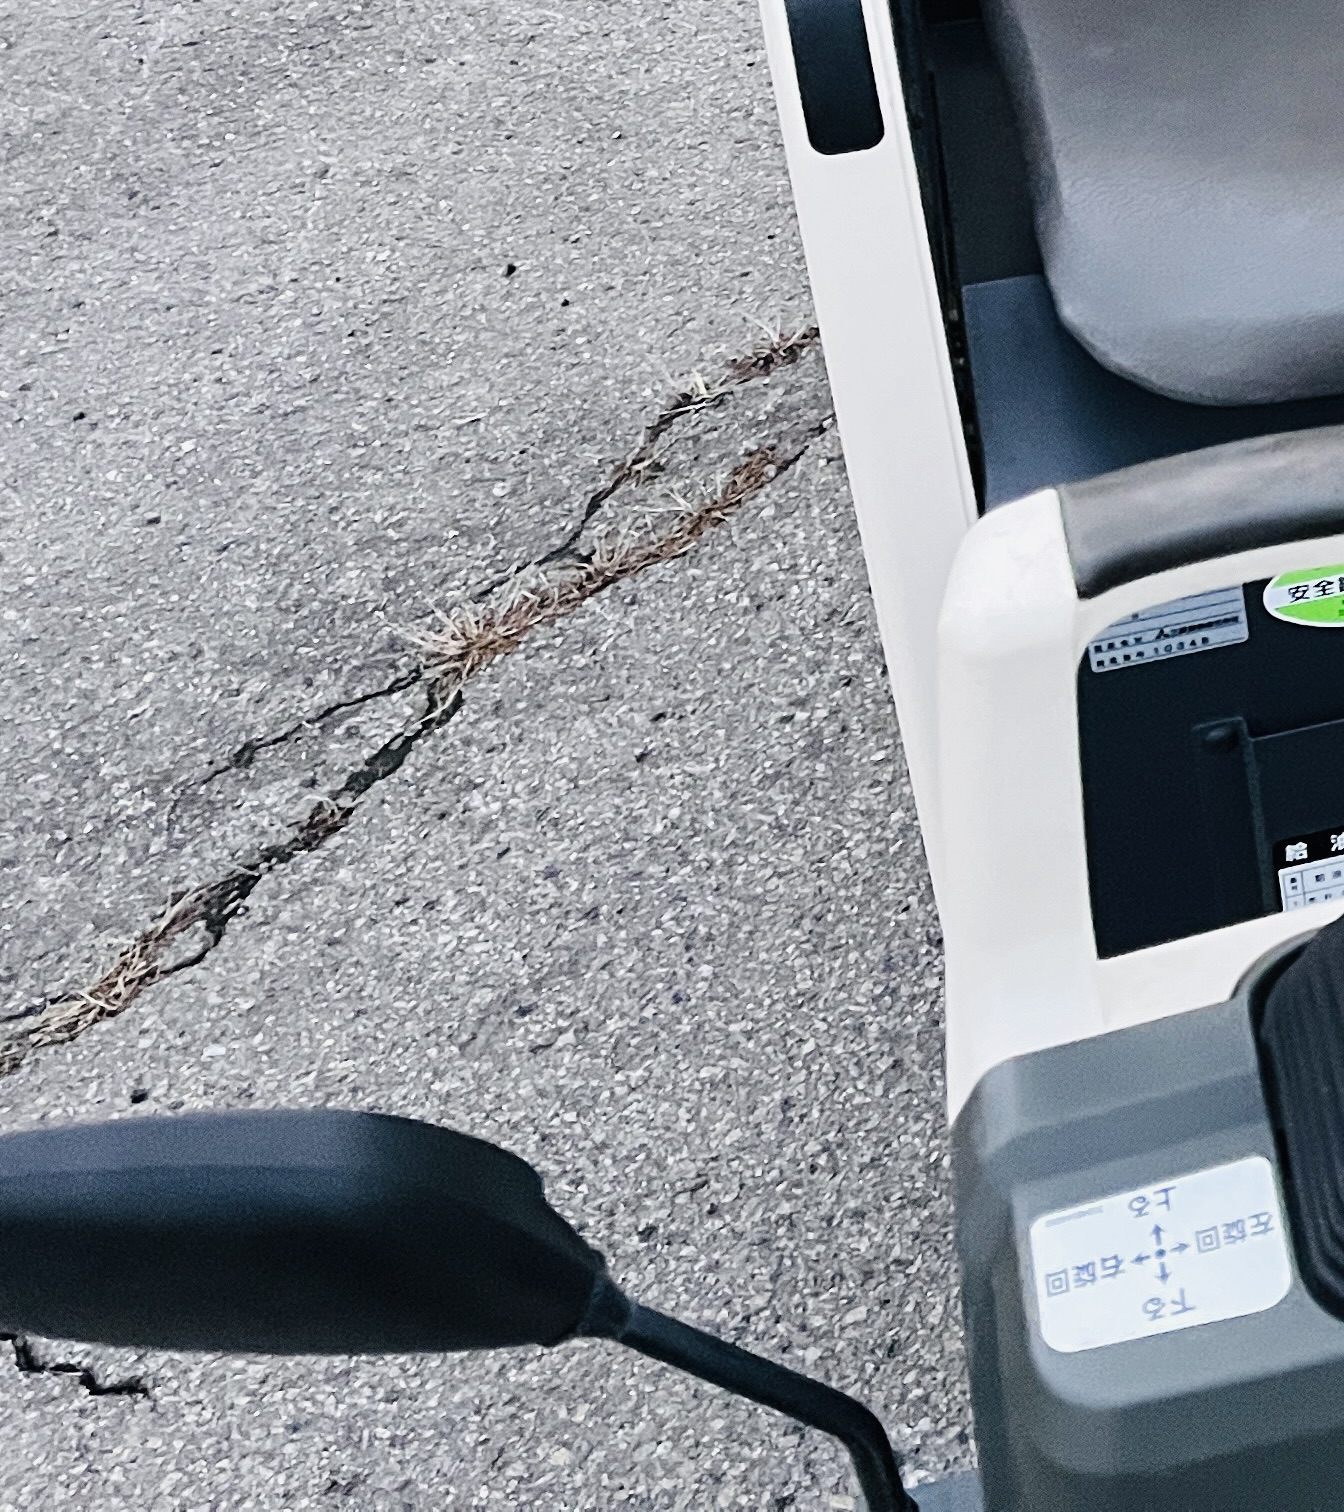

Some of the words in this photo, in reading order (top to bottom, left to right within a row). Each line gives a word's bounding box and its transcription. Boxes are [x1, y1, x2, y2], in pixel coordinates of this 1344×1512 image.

[1128, 1186, 1177, 1218] 上る
[1195, 1212, 1275, 1252] 左旋回
[1045, 1254, 1125, 1297] 右旋回
[1142, 1288, 1197, 1321] 下る
